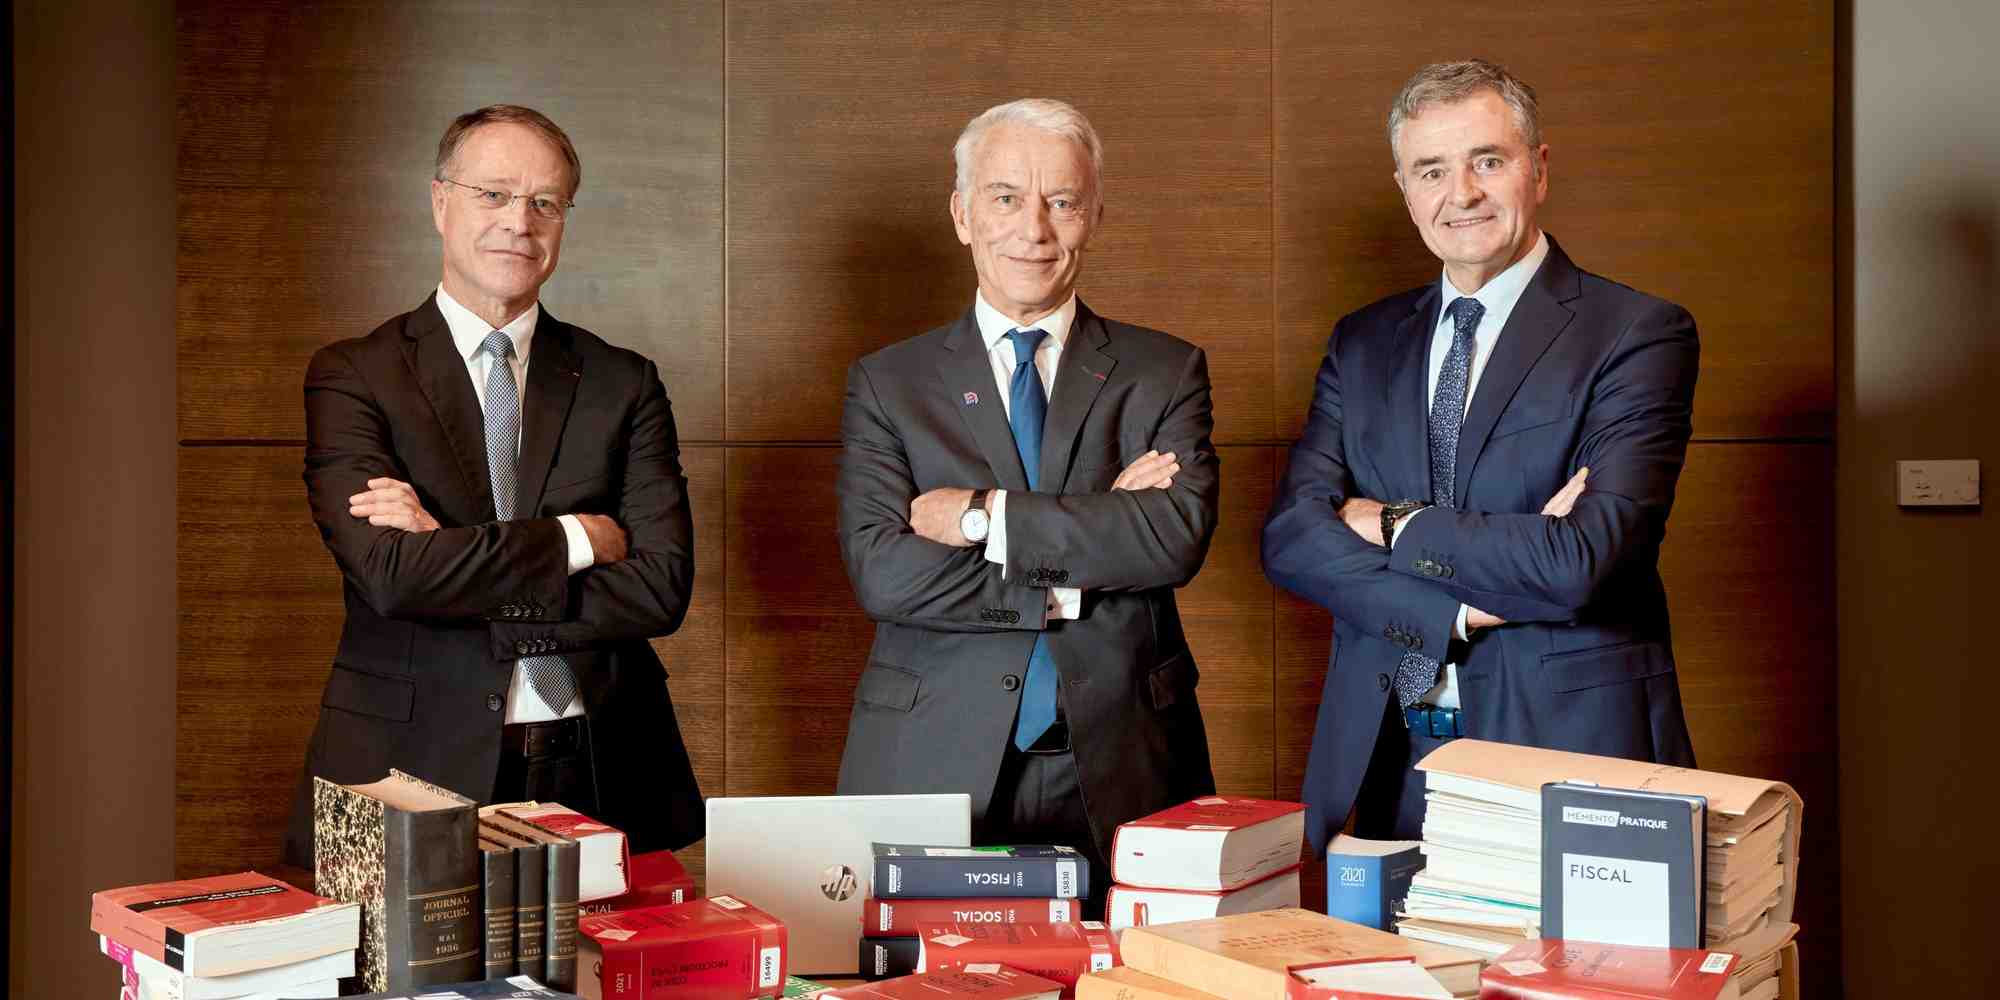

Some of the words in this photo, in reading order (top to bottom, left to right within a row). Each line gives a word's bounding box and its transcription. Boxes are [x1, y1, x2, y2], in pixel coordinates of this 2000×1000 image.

[1619, 816, 1669, 830] PRATIQUE
[964, 871, 1011, 885] FISCAL
[1340, 866, 1366, 882] 2020
[1569, 863, 1633, 884] FISCAL
[424, 896, 470, 910] JOURNAL
[424, 907, 470, 922] OFFICIEL
[953, 911, 1002, 923] SOCIAL
